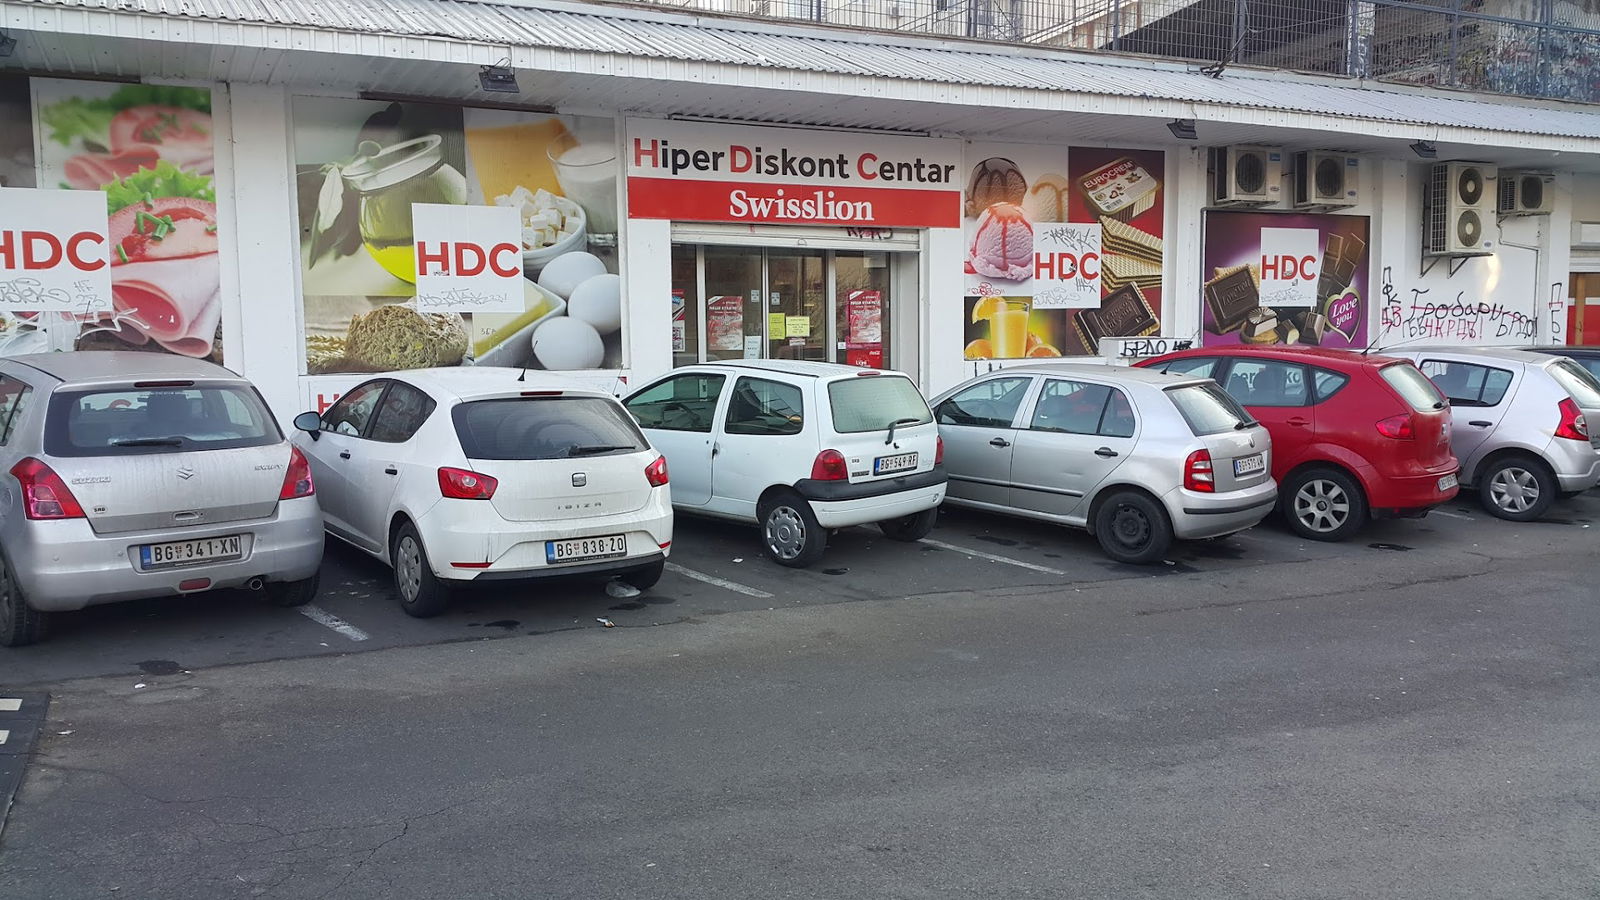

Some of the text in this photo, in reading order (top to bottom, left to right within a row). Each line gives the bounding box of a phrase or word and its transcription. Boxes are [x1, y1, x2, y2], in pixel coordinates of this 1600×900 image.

[633, 138, 955, 183] Hiper Diskont Centar
[1084, 161, 1135, 188] EUROCREM
[729, 189, 875, 222] Swisslion
[417, 241, 520, 278] HDC
[1035, 252, 1099, 280] HDC
[1261, 255, 1316, 280] HDC
[1332, 297, 1358, 318] Love
[1336, 312, 1353, 328] you
[558, 502, 602, 510] IBIZA
[154, 546, 173, 561] BG
[557, 543, 572, 557] BG
